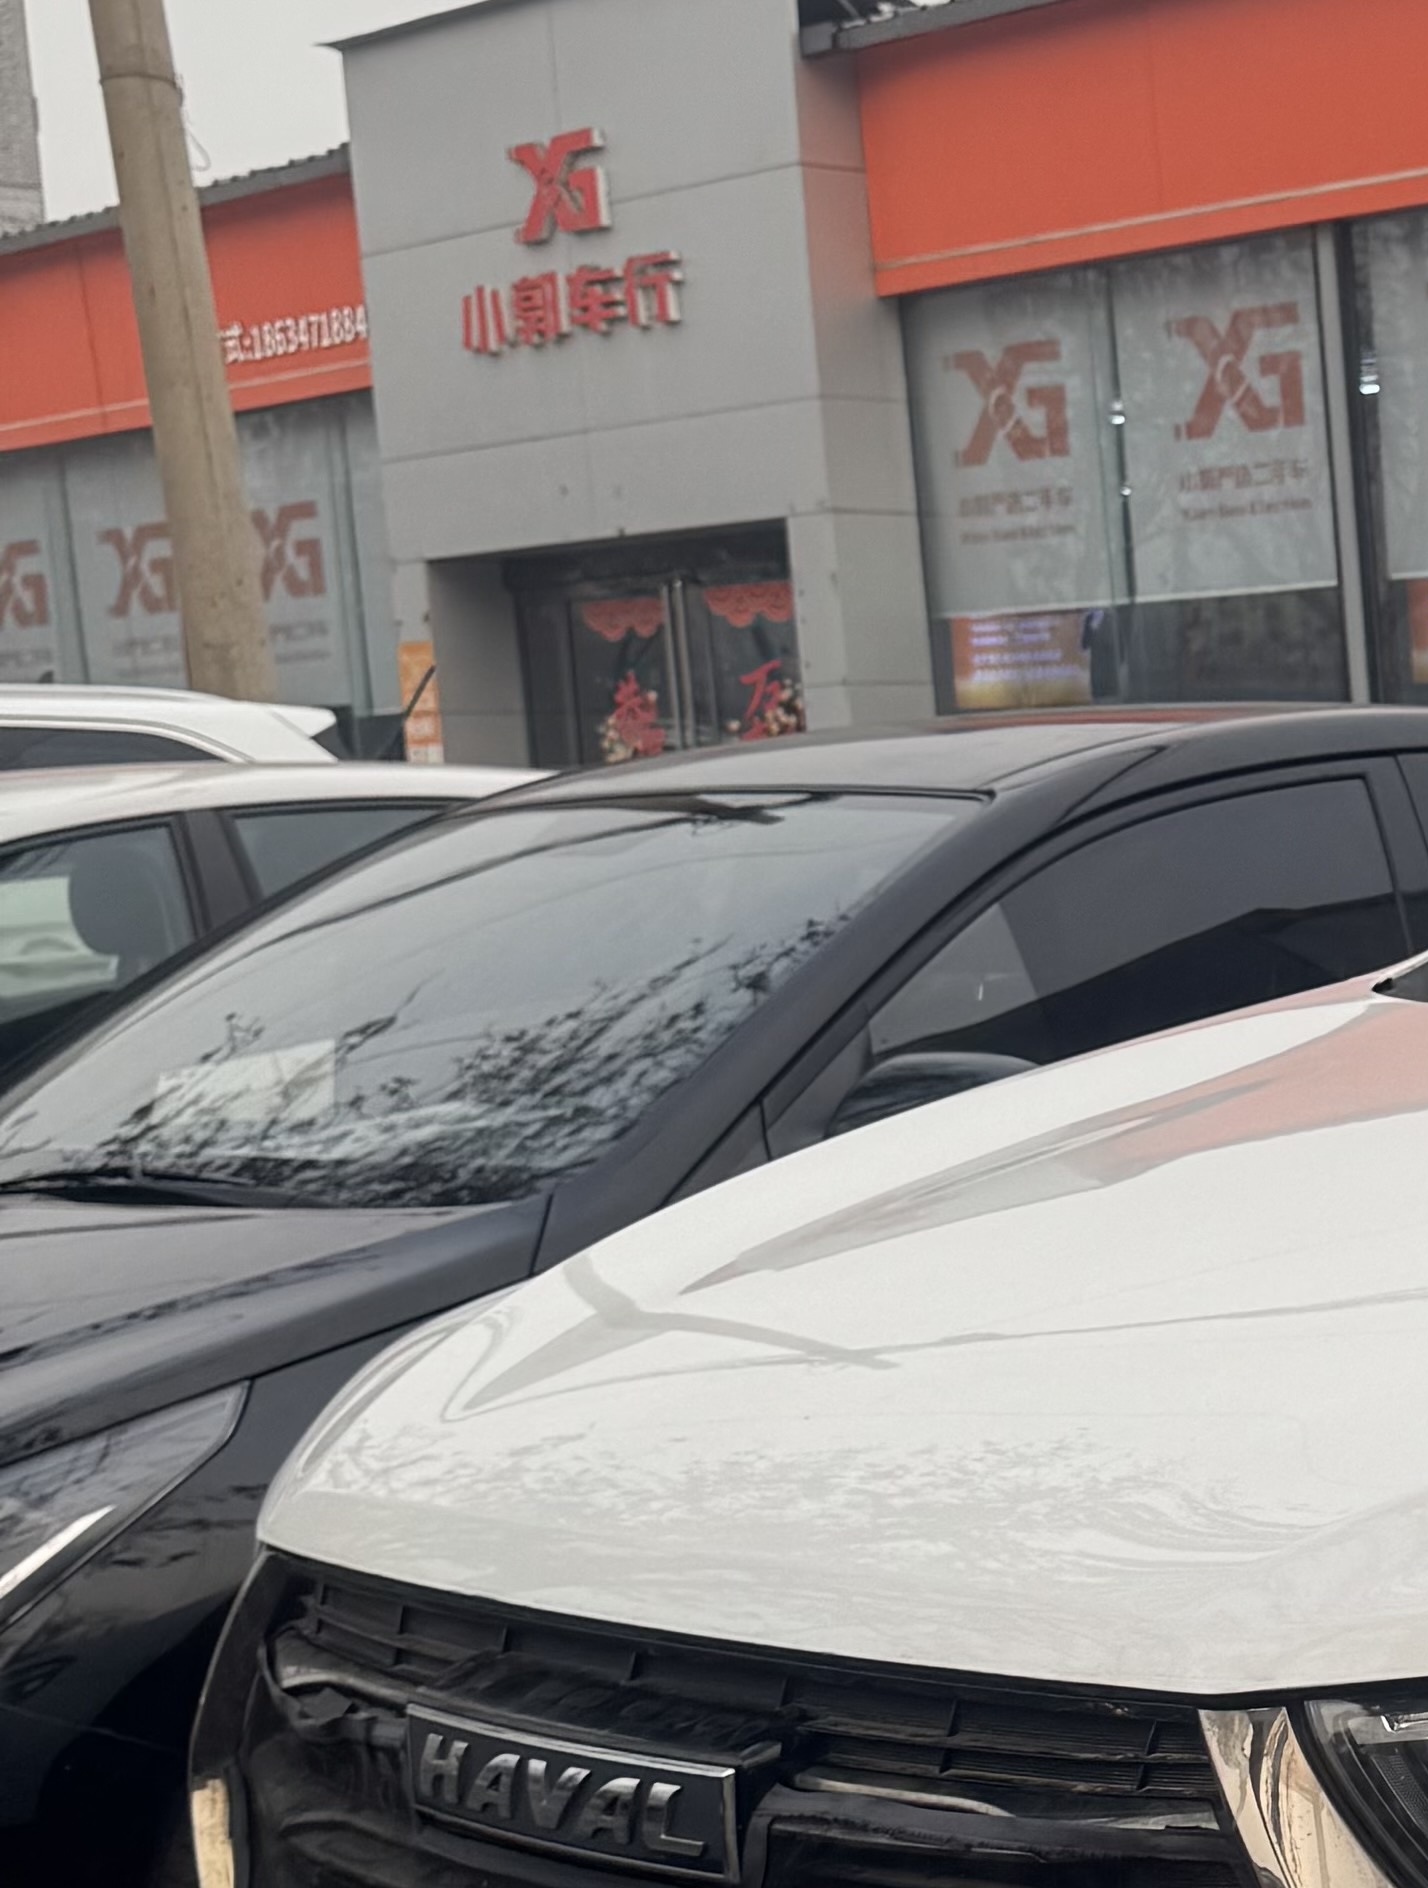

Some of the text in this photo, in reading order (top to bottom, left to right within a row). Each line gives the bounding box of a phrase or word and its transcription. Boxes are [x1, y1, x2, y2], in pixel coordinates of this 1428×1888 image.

[461, 250, 684, 357] 小郭车行
[419, 1733, 706, 1857] HAVAL
